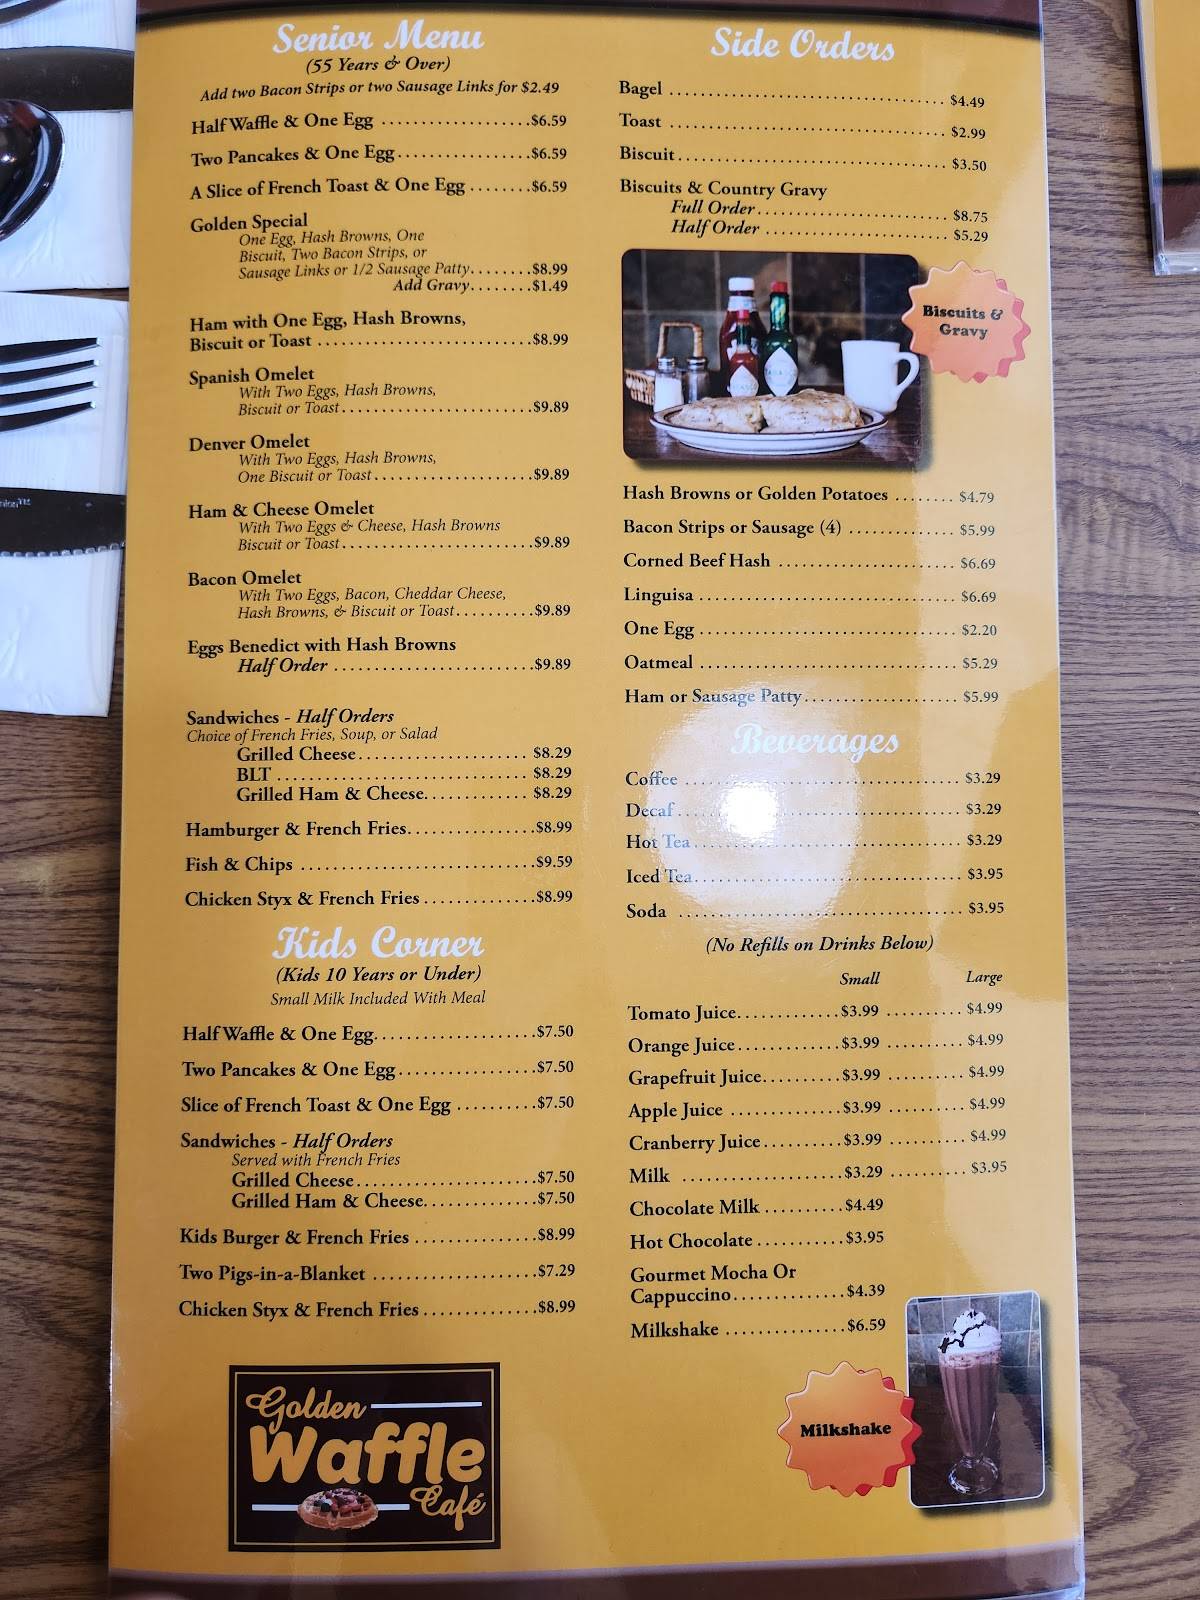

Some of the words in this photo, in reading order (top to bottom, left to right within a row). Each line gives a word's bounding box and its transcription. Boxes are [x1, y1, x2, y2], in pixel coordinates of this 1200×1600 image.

[272, 22, 372, 54] Senior
[383, 18, 485, 51] Menu
[710, 25, 781, 59] Side
[788, 26, 896, 63] Orders
[306, 59, 333, 75] (55
[339, 58, 379, 71] Years
[385, 55, 400, 70] &
[406, 56, 450, 72] Over)
[200, 88, 228, 101] Add
[232, 89, 255, 98] two
[260, 85, 301, 96] Bacon
[306, 82, 345, 97] Strips
[368, 82, 392, 92] two
[397, 81, 452, 95] Sausage
[457, 80, 494, 92] Links
[495, 80, 518, 96] for
[521, 81, 559, 93] $2.49
[619, 81, 662, 99] Bagel
[951, 95, 984, 108] $4.49
[192, 118, 227, 134] Half
[229, 115, 278, 131] Waffle
[284, 115, 298, 127] &
[304, 113, 337, 127] One
[344, 112, 373, 130] Egg
[531, 114, 566, 126] $6.59
[619, 113, 661, 127] Toast
[952, 126, 985, 139] $2.99
[620, 146, 674, 160] Biscuit
[953, 158, 986, 171] $3.50
[621, 179, 681, 193] Biscuits
[688, 181, 703, 194] &
[708, 181, 775, 200] Country
[781, 182, 827, 200] Gravy
[671, 200, 703, 213] Full
[708, 200, 755, 214] Order
[954, 209, 987, 223] $8.75
[191, 216, 247, 232] Golden
[252, 212, 307, 233] Special
[240, 234, 266, 246] One
[270, 232, 295, 248] Egg,
[301, 230, 334, 243] Hash
[339, 230, 391, 242] Browns,
[397, 229, 424, 241] One
[393, 278, 422, 291] Add
[427, 279, 469, 294] Gravy
[533, 280, 568, 292] $1.49
[923, 305, 985, 319] Biscuits
[991, 309, 1003, 320] &
[939, 324, 987, 340] Gravy
[189, 368, 249, 389] Spanish
[256, 366, 314, 381] Omelet
[189, 438, 245, 451] Denver
[251, 433, 310, 449] Omelet
[624, 485, 664, 499] Hash
[670, 486, 730, 499] Browns
[736, 491, 752, 500] or
[758, 486, 816, 500] Golden
[822, 487, 888, 500] Potatoes
[960, 491, 994, 503] $4.79
[624, 553, 683, 567] Corned
[690, 553, 726, 567] Beef
[730, 553, 770, 567] Hash
[961, 557, 995, 569] $6.69
[188, 573, 236, 586] Bacon
[242, 570, 301, 585] Omelet
[239, 589, 270, 601] With
[276, 589, 302, 601] Two
[307, 589, 339, 604] Eggs,
[345, 588, 389, 601] Bacon,
[395, 587, 453, 599] Cheddar
[457, 587, 505, 600] Cheese,
[624, 587, 693, 606] Linguisa
[962, 590, 996, 603] $6.69
[237, 657, 278, 677] Half
[280, 657, 328, 672] Order
[535, 658, 570, 671] $9.89
[625, 655, 692, 669] Oatmeal
[963, 658, 997, 669] $5.29
[187, 730, 230, 742] Choice
[234, 728, 249, 745] of
[251, 728, 295, 741] French
[300, 729, 334, 741] Fries,
[341, 728, 376, 744] Soup,
[382, 731, 396, 739] or
[400, 727, 438, 739] Salad
[730, 722, 900, 764] Beverages
[236, 767, 271, 781] BLT
[534, 767, 571, 779] $8.29
[626, 771, 677, 786] Coffee
[966, 773, 1000, 783] $3.29
[185, 857, 218, 871] Fish
[224, 858, 239, 871] &
[245, 856, 292, 875] Chips
[537, 856, 572, 867] $9.59
[627, 903, 666, 918] Soda
[969, 902, 1004, 914] $3.95
[271, 926, 358, 960] Kids
[371, 925, 485, 960] Corner
[707, 937, 734, 954] (No
[740, 936, 789, 956] Refills
[794, 942, 813, 951] on
[819, 935, 875, 950] Drinks
[880, 935, 933, 952] Below)
[277, 967, 320, 984] (Kids
[326, 968, 346, 981] 10
[353, 967, 394, 981] Years
[400, 972, 417, 980] or
[424, 965, 481, 983] Under)
[840, 972, 880, 985] Small
[966, 971, 1002, 986] Large
[271, 992, 309, 1005] Small
[313, 992, 344, 1005] Milk
[349, 991, 408, 1004] Included
[414, 991, 446, 1004] With
[451, 990, 485, 1003] Meal
[628, 1006, 690, 1020] Tomato
[695, 1005, 736, 1023] Juice
[841, 1005, 878, 1017] $3.99
[967, 1002, 1002, 1015] $4.99
[232, 1153, 277, 1166] Served
[282, 1153, 311, 1166] with
[316, 1152, 362, 1166] French
[367, 1153, 400, 1165] Fries
[630, 1167, 670, 1183] Milk
[845, 1166, 882, 1179] $3.29
[971, 1161, 1007, 1174] $3.95
[180, 1228, 217, 1243] Kids
[223, 1229, 279, 1249] Burger
[285, 1230, 301, 1244] &
[307, 1229, 363, 1244] French
[370, 1229, 409, 1244] Fries
[538, 1228, 575, 1241] $8.99
[179, 1264, 213, 1280] Two
[219, 1265, 365, 1286] Pigs-in-a-Blanket
[539, 1264, 575, 1277] $7.29
[631, 1267, 705, 1282] Gourmet
[711, 1264, 768, 1280] Mocha
[773, 1264, 796, 1278] Or
[631, 1288, 730, 1308] Cappuccino
[847, 1284, 885, 1298] $4.39
[631, 1320, 718, 1338] Milkshake
[848, 1319, 885, 1332] $6.59
[245, 1385, 367, 1434] Golden
[801, 1422, 891, 1437] Milkshake
[249, 1420, 486, 1485] Waffle
[410, 1484, 486, 1532] Café
